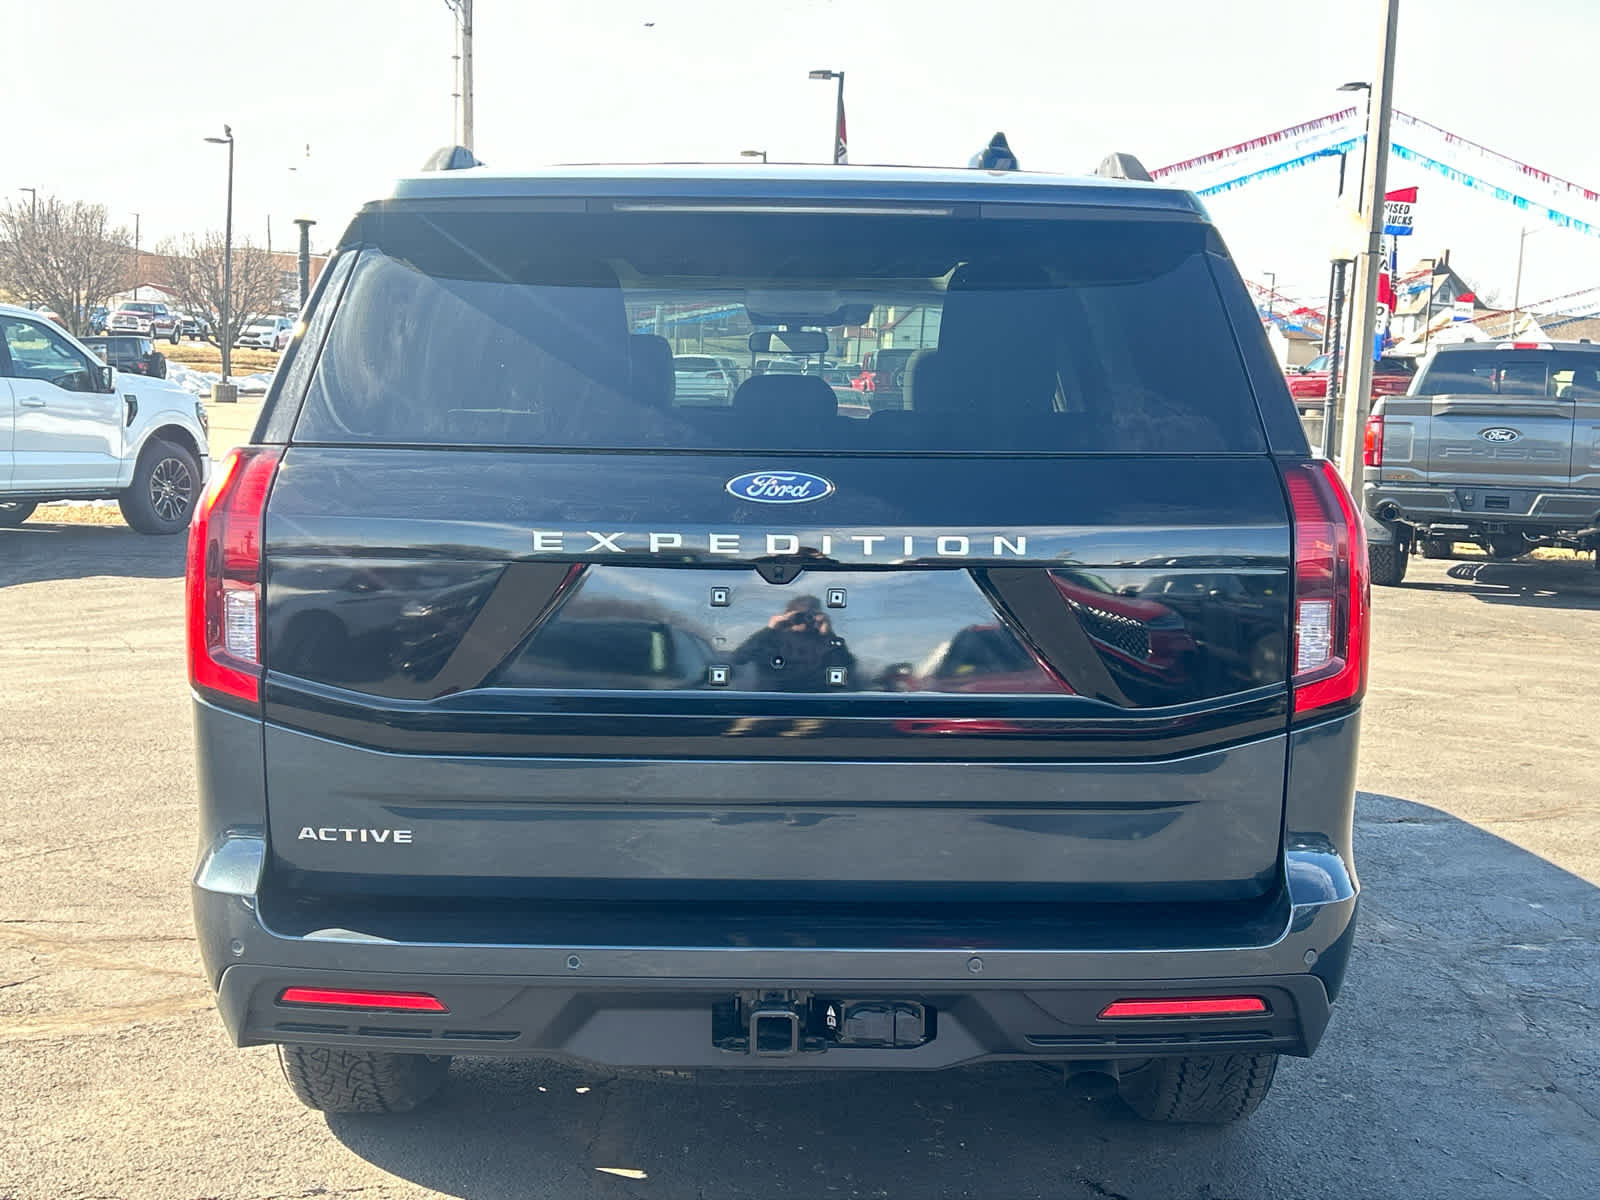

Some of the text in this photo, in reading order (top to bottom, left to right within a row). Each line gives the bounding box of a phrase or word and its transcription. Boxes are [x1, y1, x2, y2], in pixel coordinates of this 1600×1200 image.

[1387, 215, 1413, 225] UCKS
[1488, 430, 1512, 441] Ford
[746, 475, 811, 497] Ford
[532, 530, 1026, 556] EXPEDITION
[298, 827, 412, 843] ACTIVE
